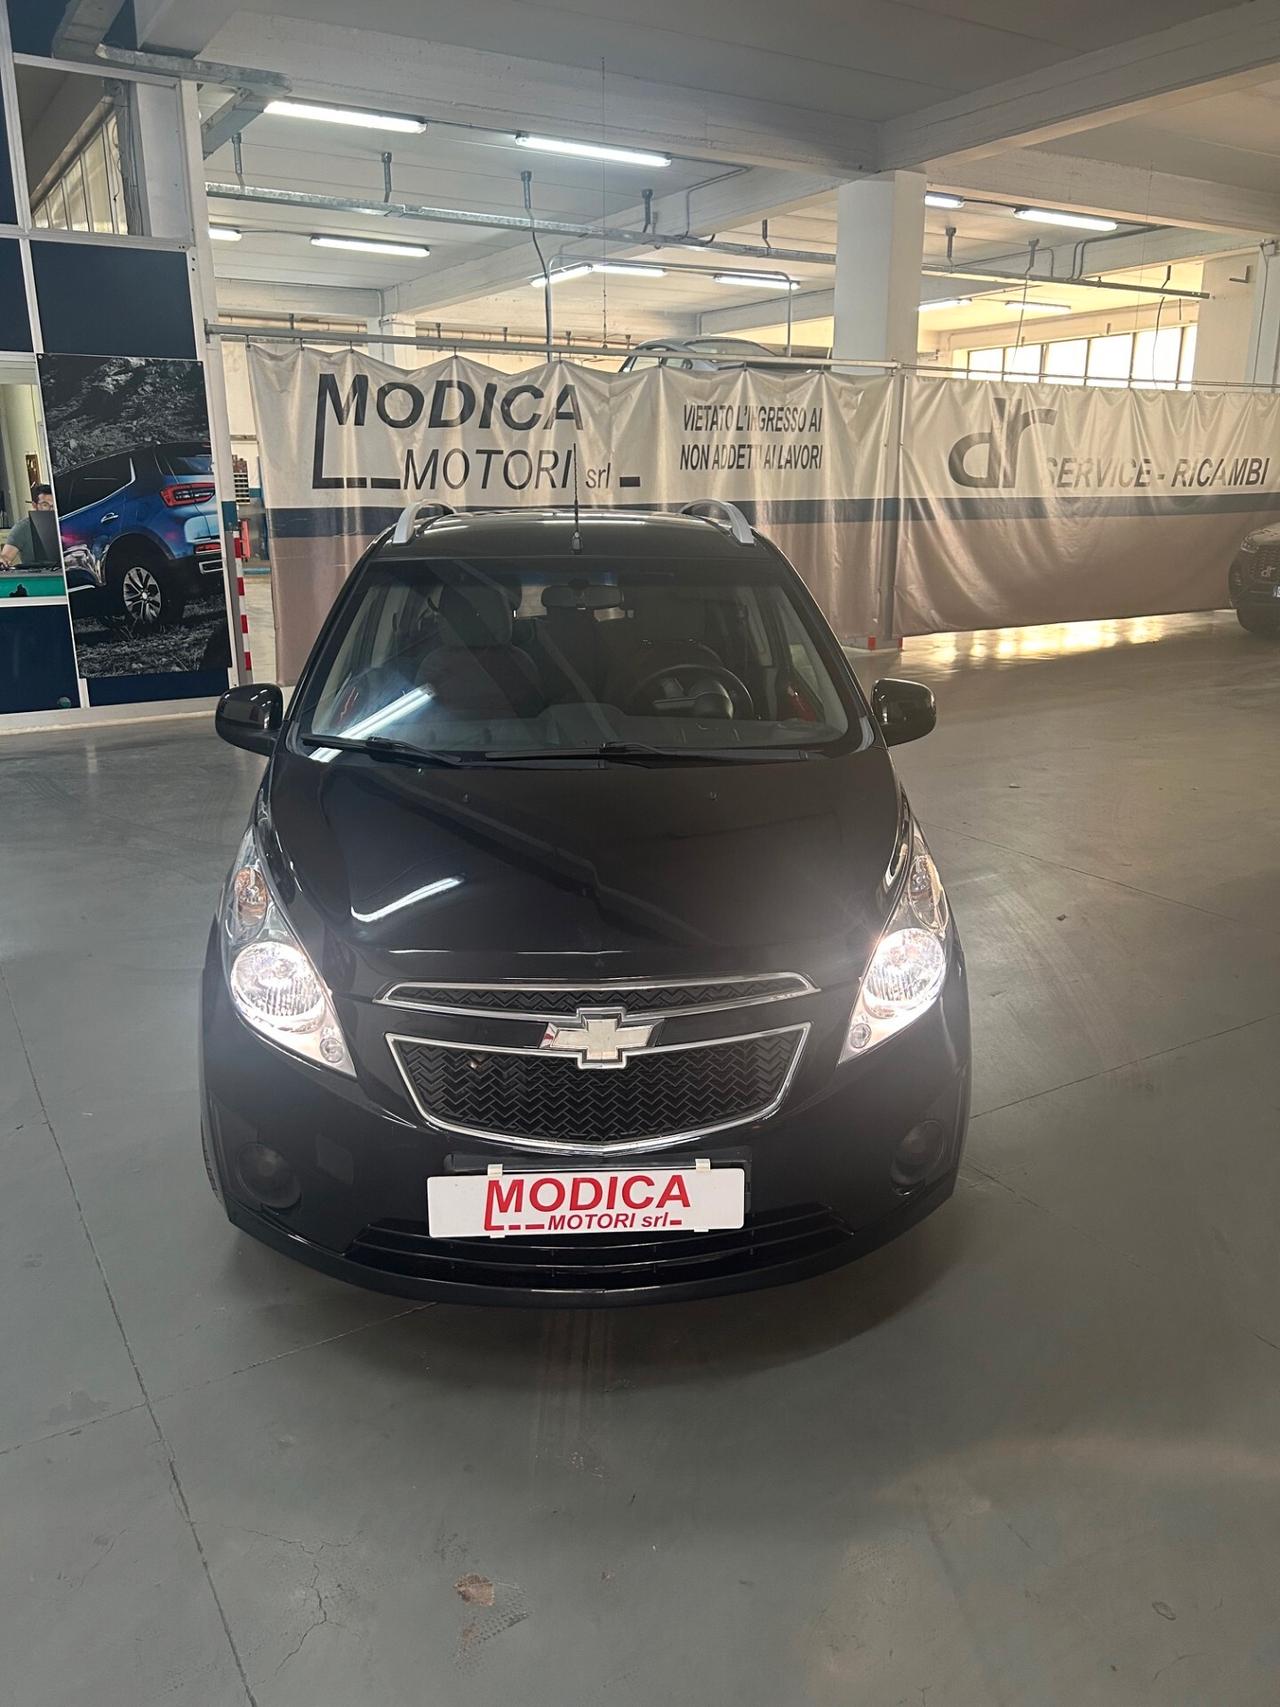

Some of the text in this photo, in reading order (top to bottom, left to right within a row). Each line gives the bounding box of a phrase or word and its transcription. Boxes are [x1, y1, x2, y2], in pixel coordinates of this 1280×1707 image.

[316, 373, 584, 431] MODICA
[683, 404, 823, 432] VIETATO L'INGRESSO AI
[403, 448, 611, 490] MOTORI srl
[680, 444, 710, 470] NON
[763, 444, 777, 470] AI
[777, 444, 823, 470] LAVORI
[1046, 456, 1151, 488] SERVICE
[1170, 457, 1270, 487] RICAMBI
[486, 1174, 691, 1213] MODICA
[548, 1212, 668, 1231] MOTORI srl
